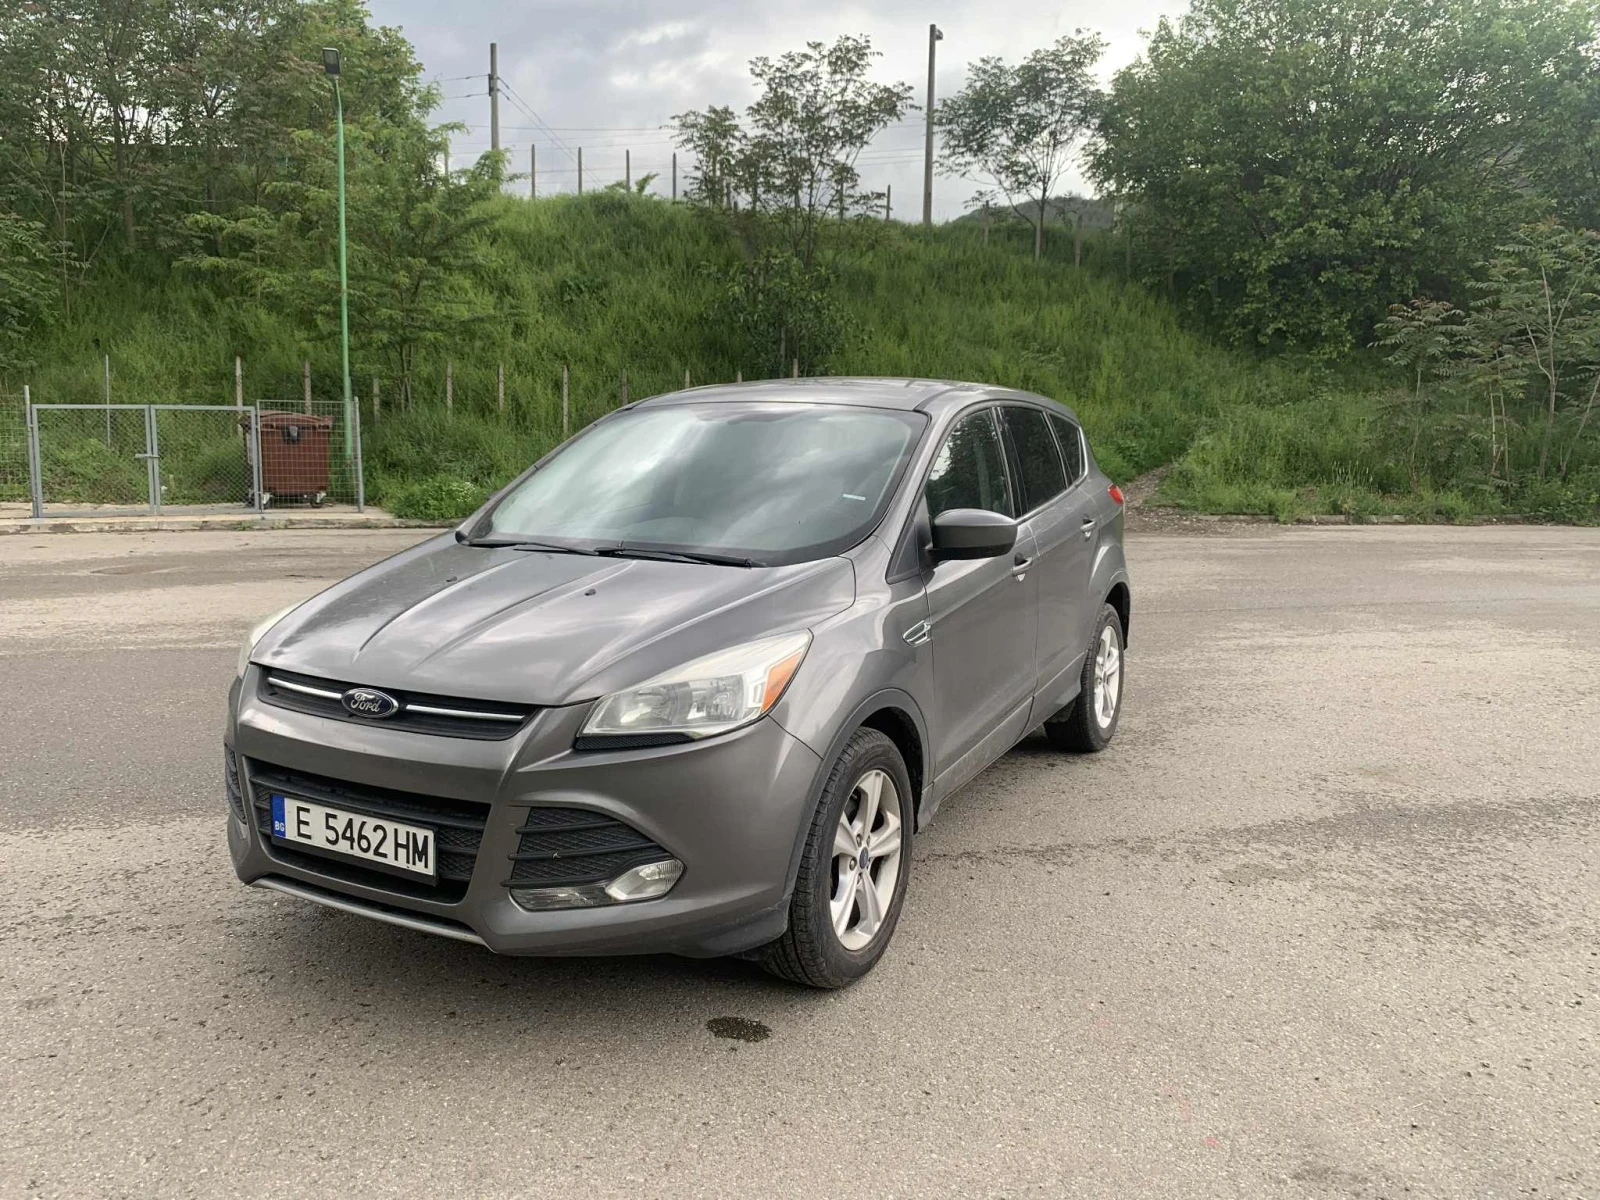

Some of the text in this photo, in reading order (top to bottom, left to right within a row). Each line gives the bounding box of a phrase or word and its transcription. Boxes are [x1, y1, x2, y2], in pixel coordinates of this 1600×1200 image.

[351, 692, 382, 712] Ford
[274, 820, 285, 832] BG
[296, 805, 312, 840] E
